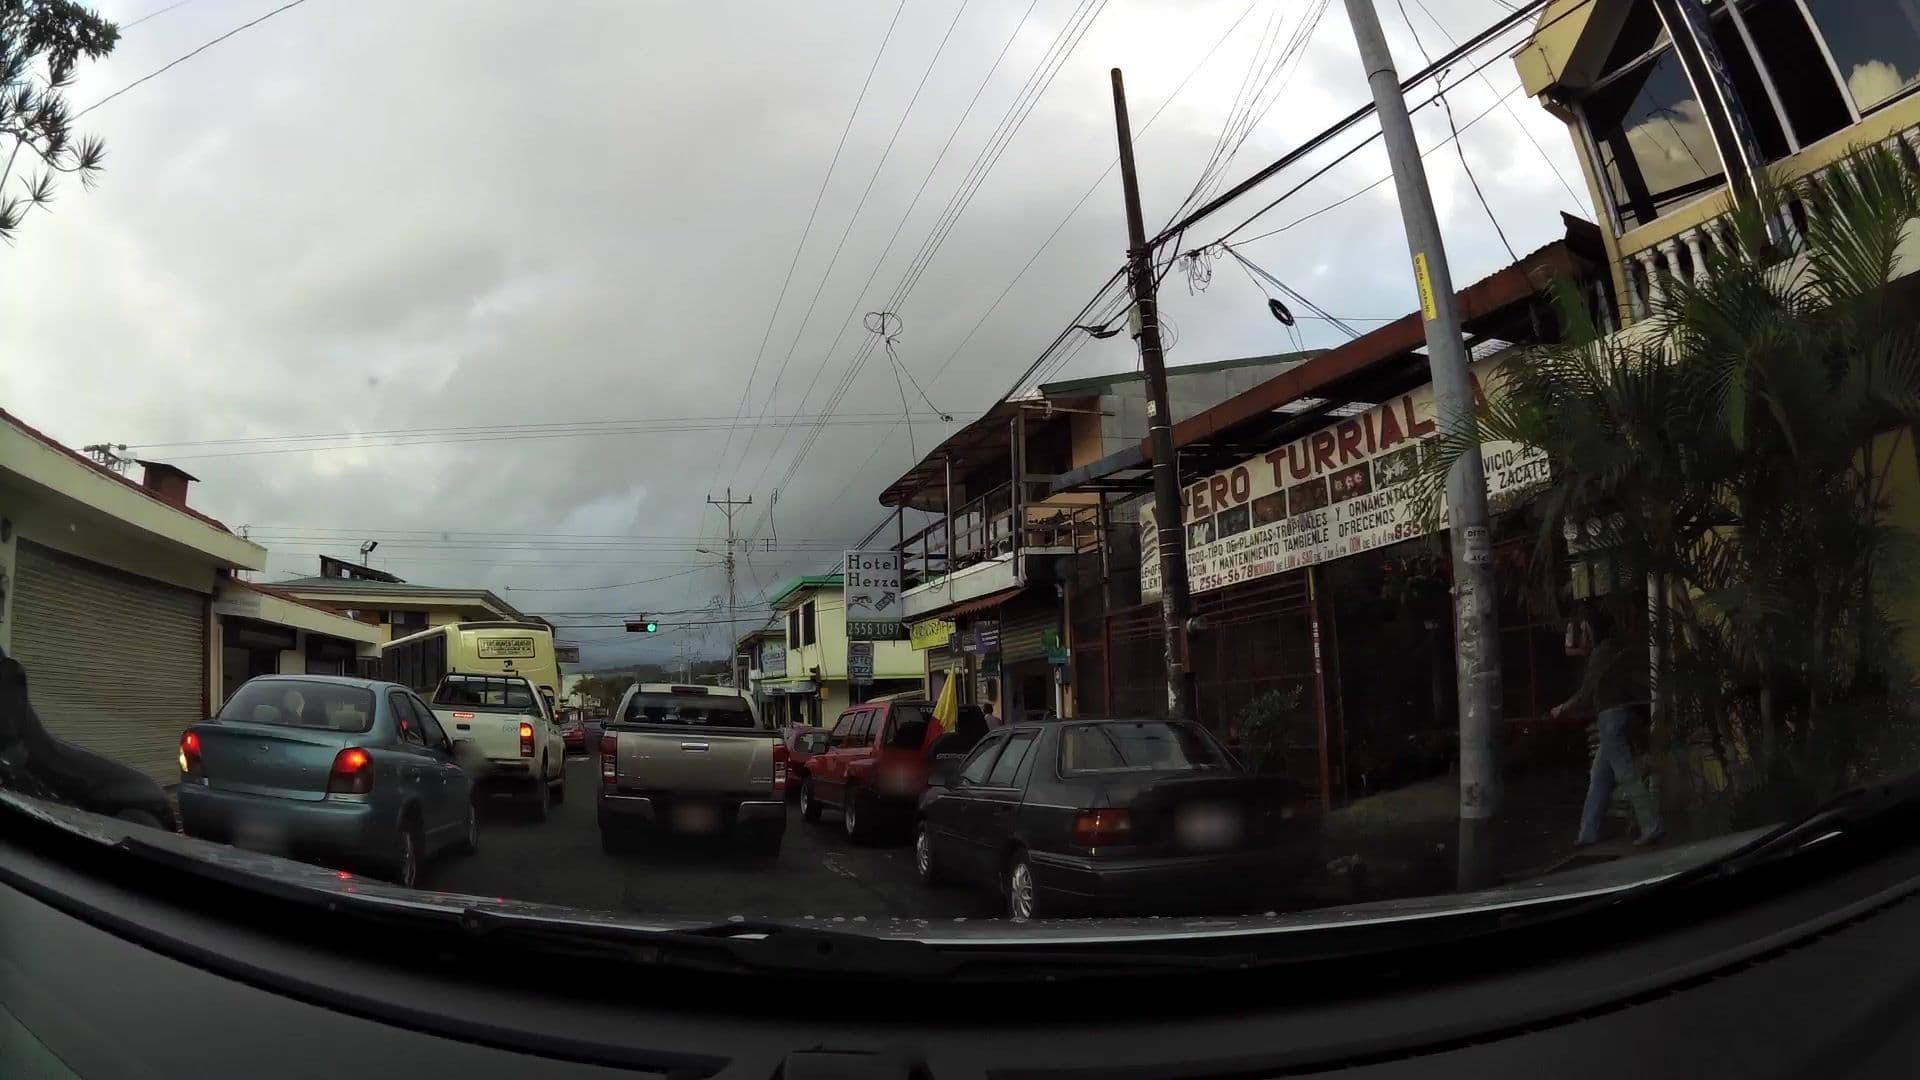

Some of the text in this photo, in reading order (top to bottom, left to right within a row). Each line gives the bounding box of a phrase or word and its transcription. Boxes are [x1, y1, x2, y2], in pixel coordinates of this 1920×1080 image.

[1335, 506, 1341, 521] Y
[1483, 449, 1513, 473] VICIO
[1142, 576, 1161, 590] CLIENT
[1219, 543, 1279, 571] MANTENIMIENTO
[1338, 508, 1395, 537] OFRECEMOS
[1498, 457, 1548, 489] ZACATE
[848, 554, 899, 570] Hotel
[848, 572, 899, 588] Herza
[1200, 564, 1253, 591] 2556-5678
